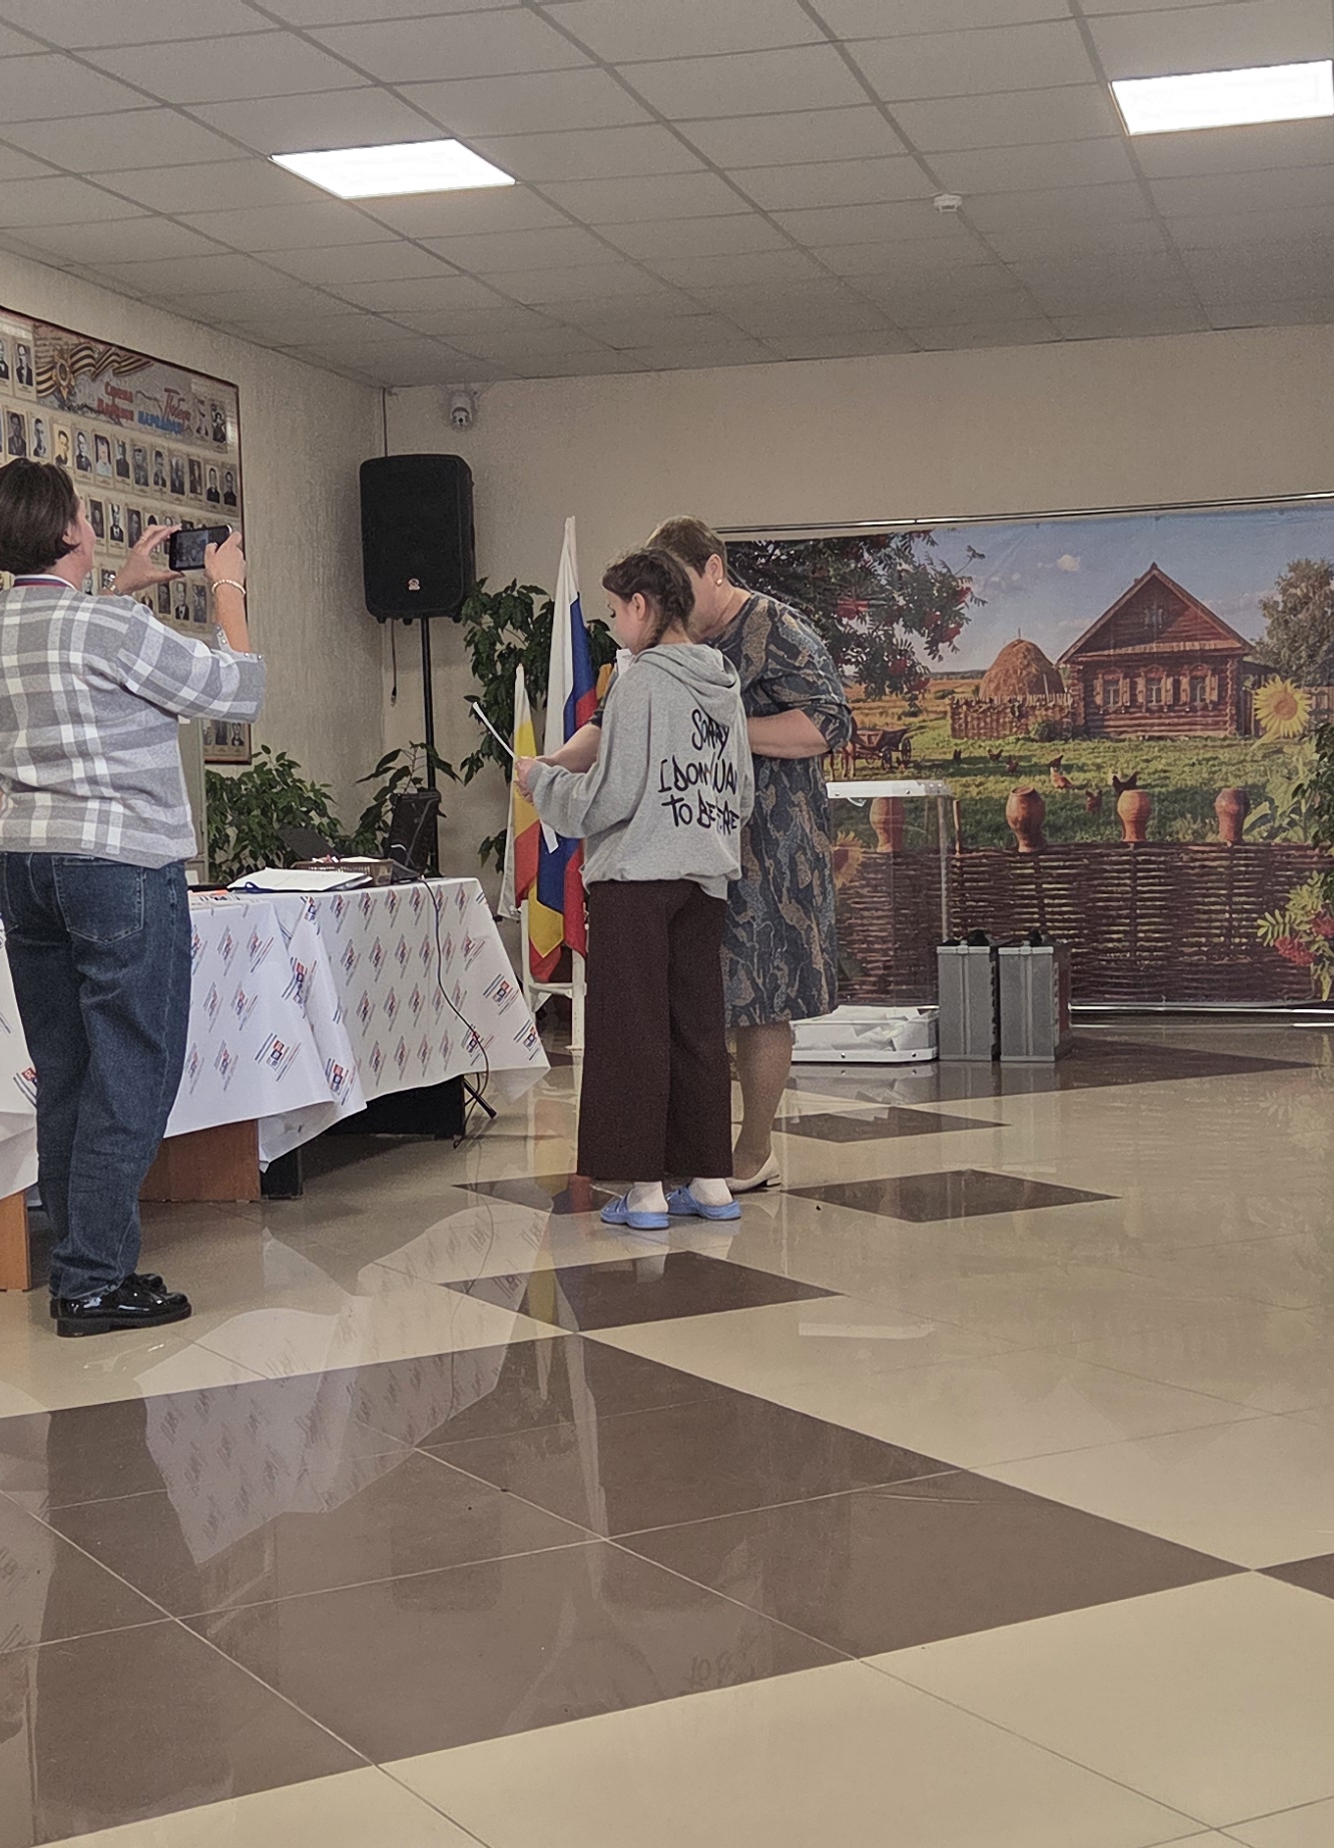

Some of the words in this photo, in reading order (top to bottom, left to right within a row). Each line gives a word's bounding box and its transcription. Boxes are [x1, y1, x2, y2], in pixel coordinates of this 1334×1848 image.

[692, 709, 729, 760] SORRY
[658, 759, 672, 793] I
[661, 794, 692, 827] TO
[697, 789, 716, 829] BE
